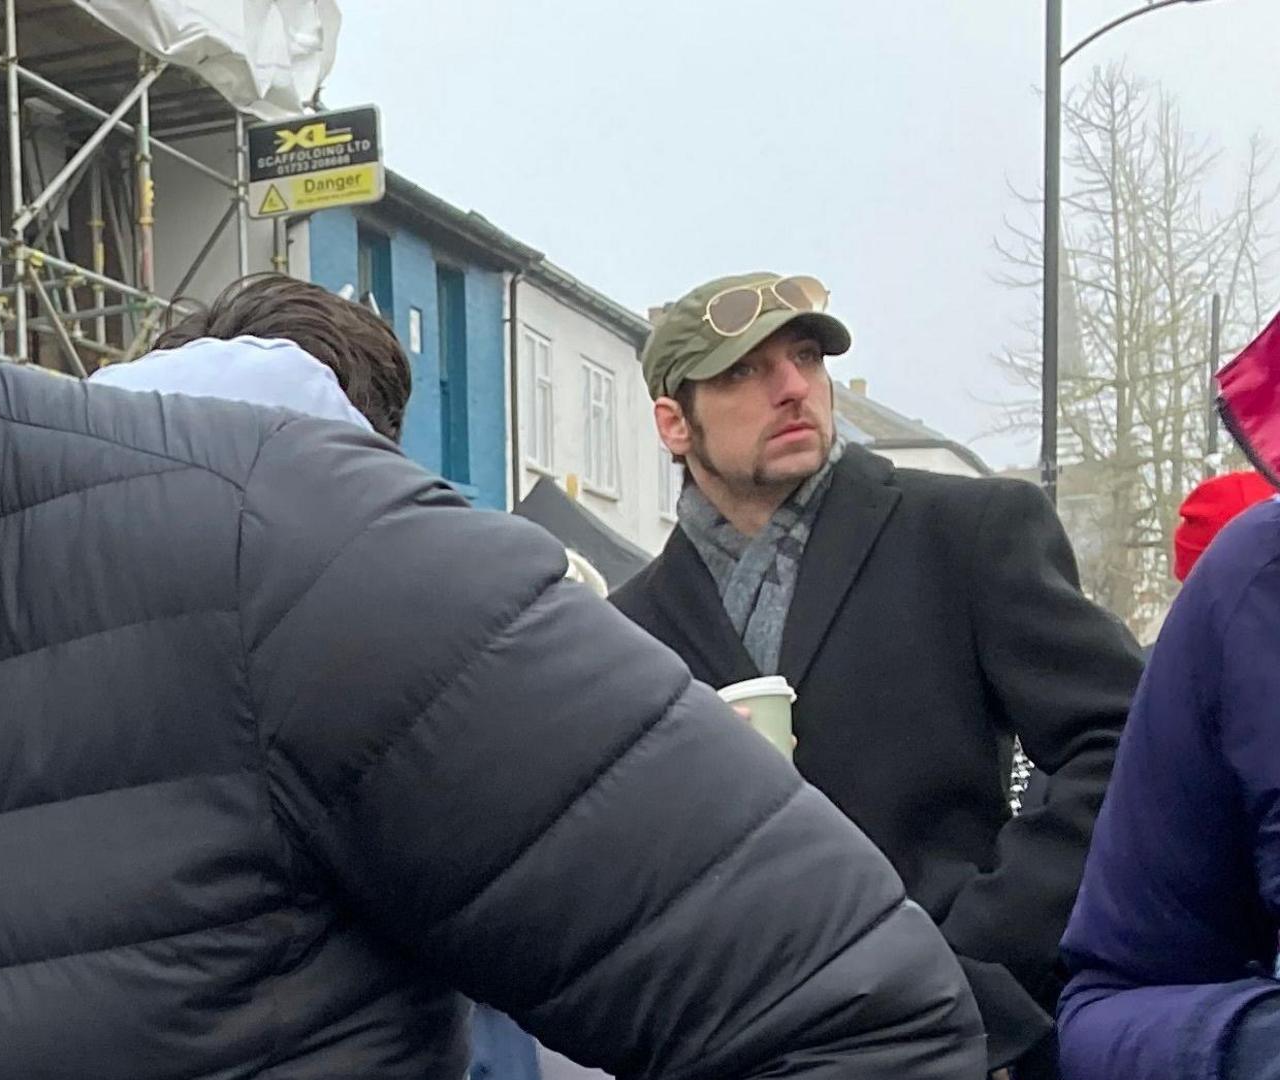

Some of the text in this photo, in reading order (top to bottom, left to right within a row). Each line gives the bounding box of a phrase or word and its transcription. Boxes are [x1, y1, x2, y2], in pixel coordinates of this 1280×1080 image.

[274, 122, 353, 154] XL
[258, 139, 371, 169] SCAFFOLDING LTD
[304, 174, 362, 194] Danger
